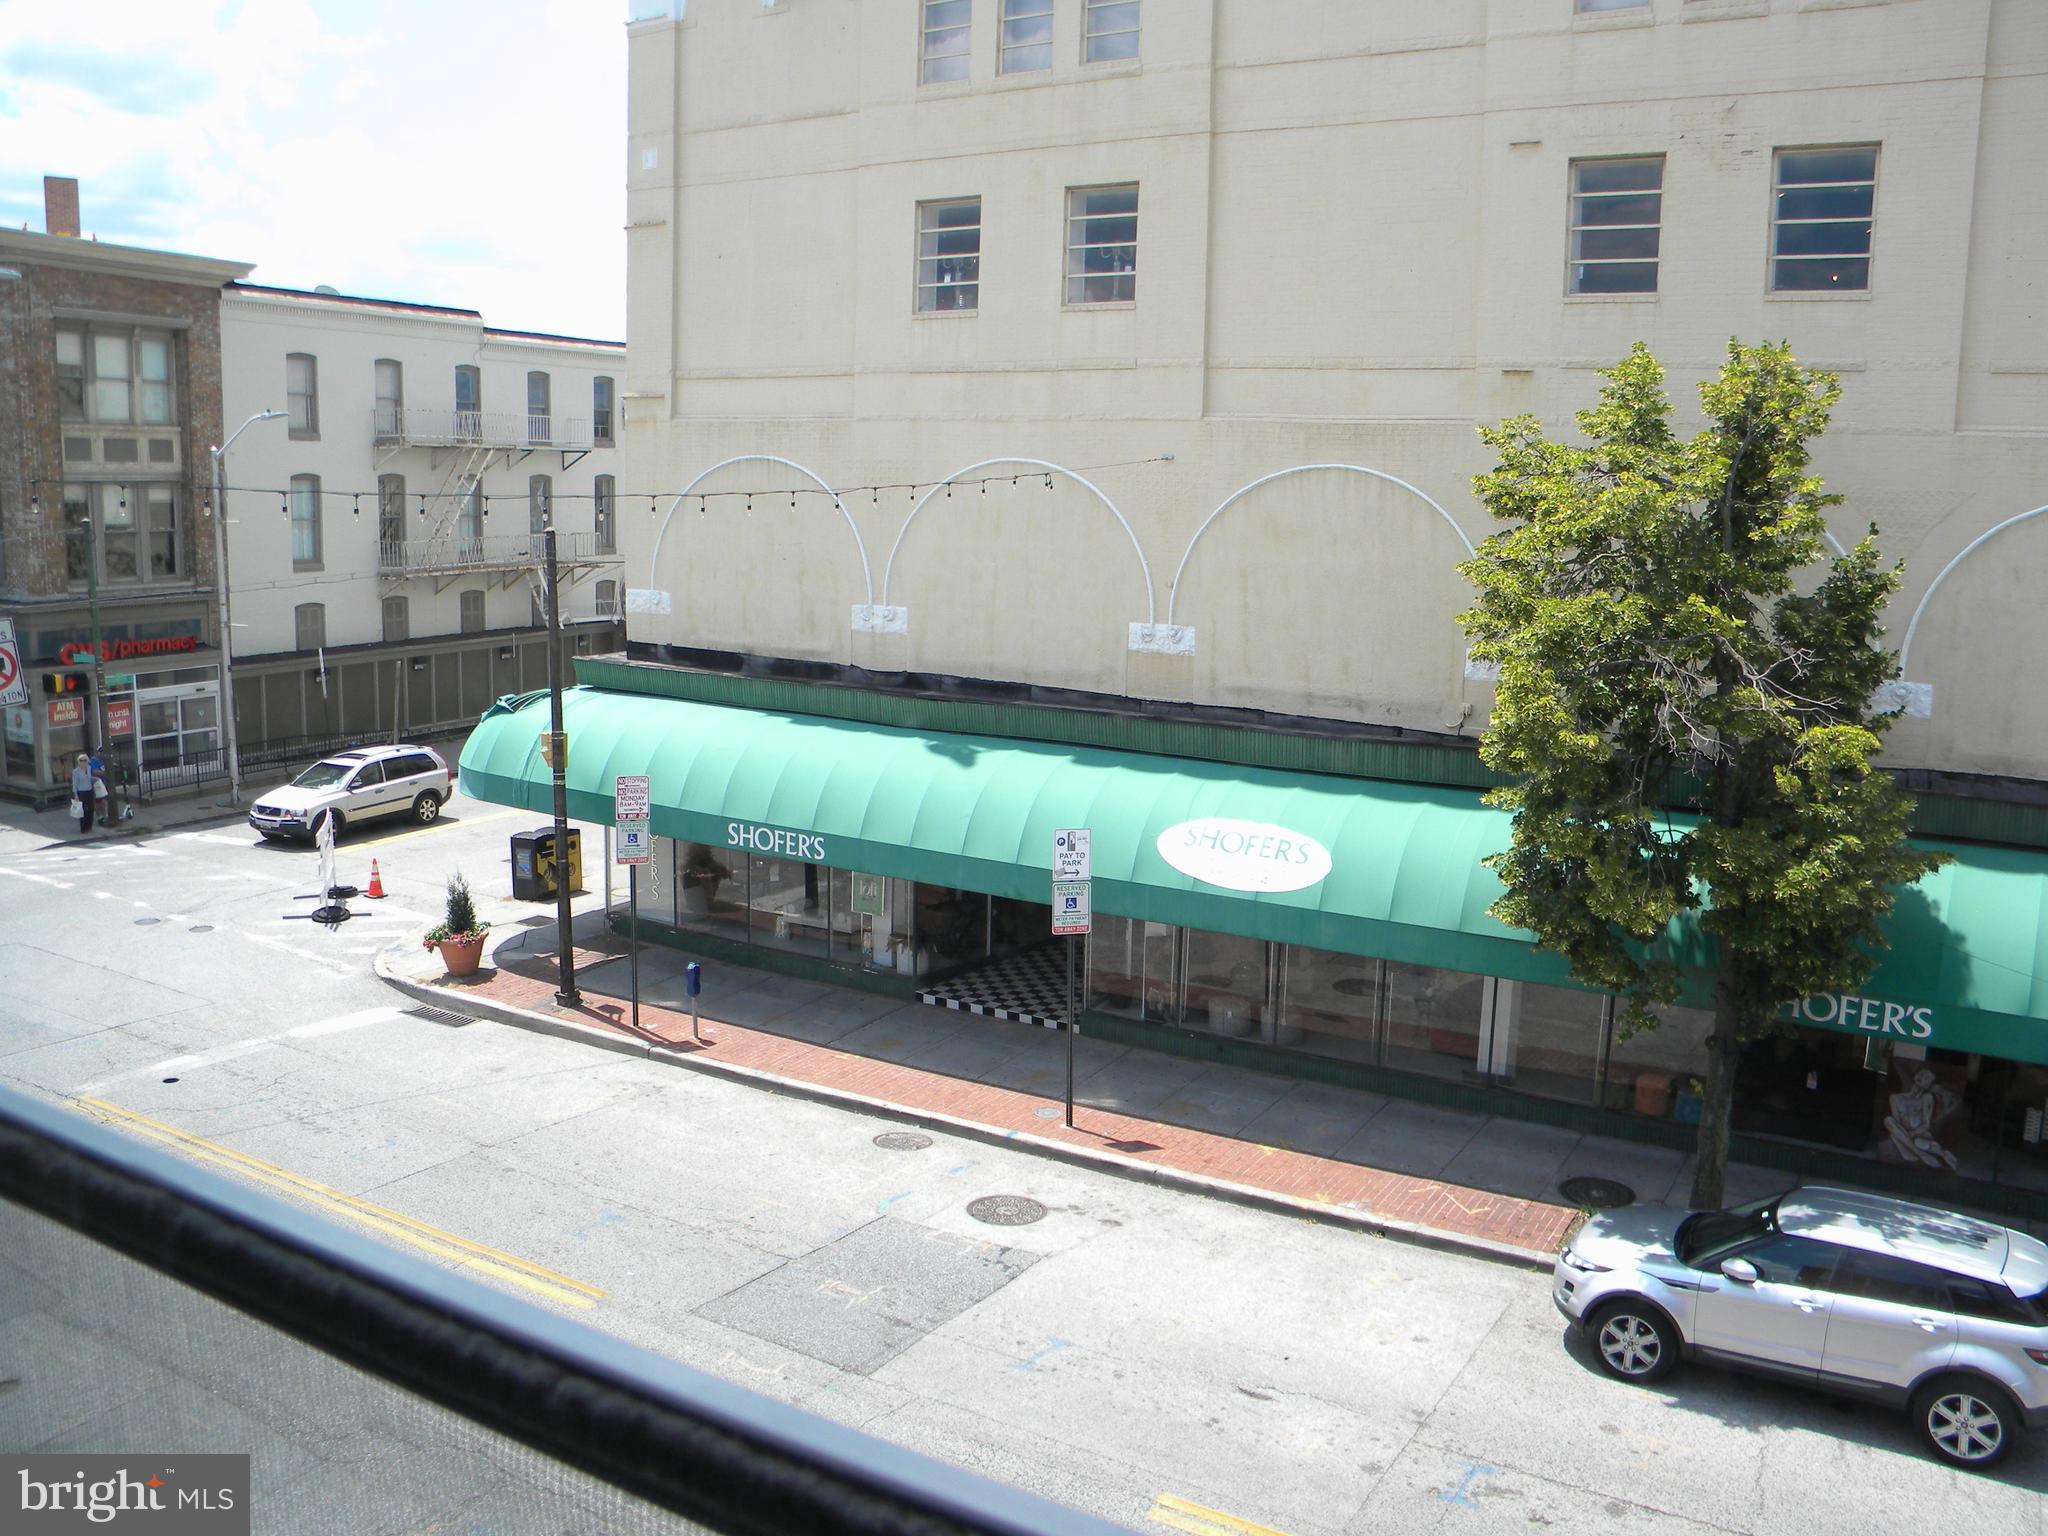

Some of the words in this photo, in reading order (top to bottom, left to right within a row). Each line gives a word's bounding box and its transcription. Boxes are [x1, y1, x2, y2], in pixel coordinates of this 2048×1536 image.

[54, 710, 79, 721] inside
[56, 701, 75, 711] ATM
[728, 823, 825, 860] SHOFER'S
[1183, 825, 1311, 864] SHOFER'S
